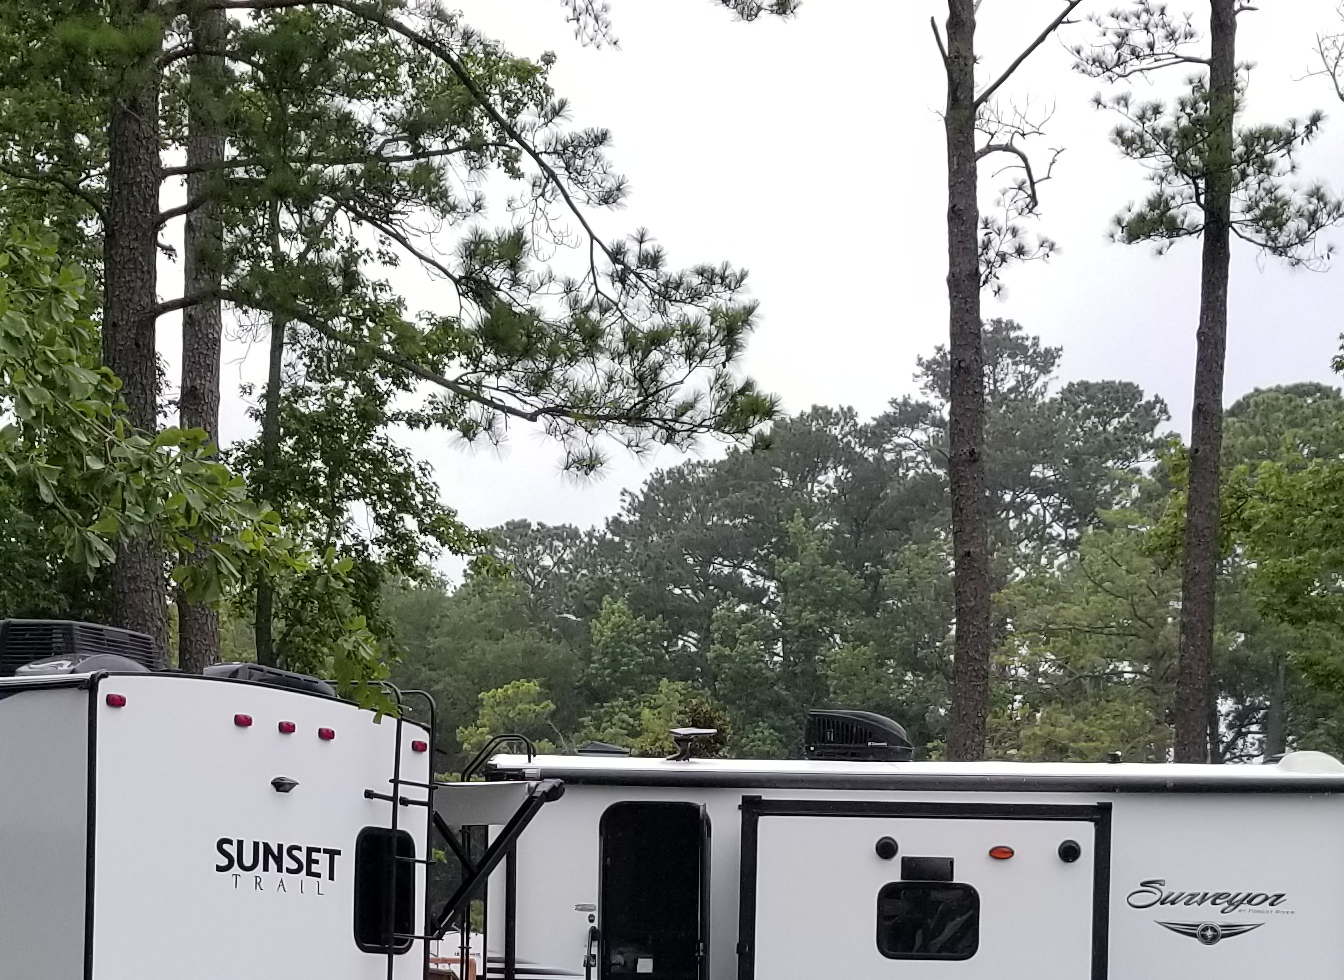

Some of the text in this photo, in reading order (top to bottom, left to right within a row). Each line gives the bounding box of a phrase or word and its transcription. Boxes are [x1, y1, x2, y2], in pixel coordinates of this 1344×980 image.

[215, 837, 342, 882] SUNSET
[232, 873, 325, 896] TRAIL
[1126, 879, 1287, 915] Surveyor
